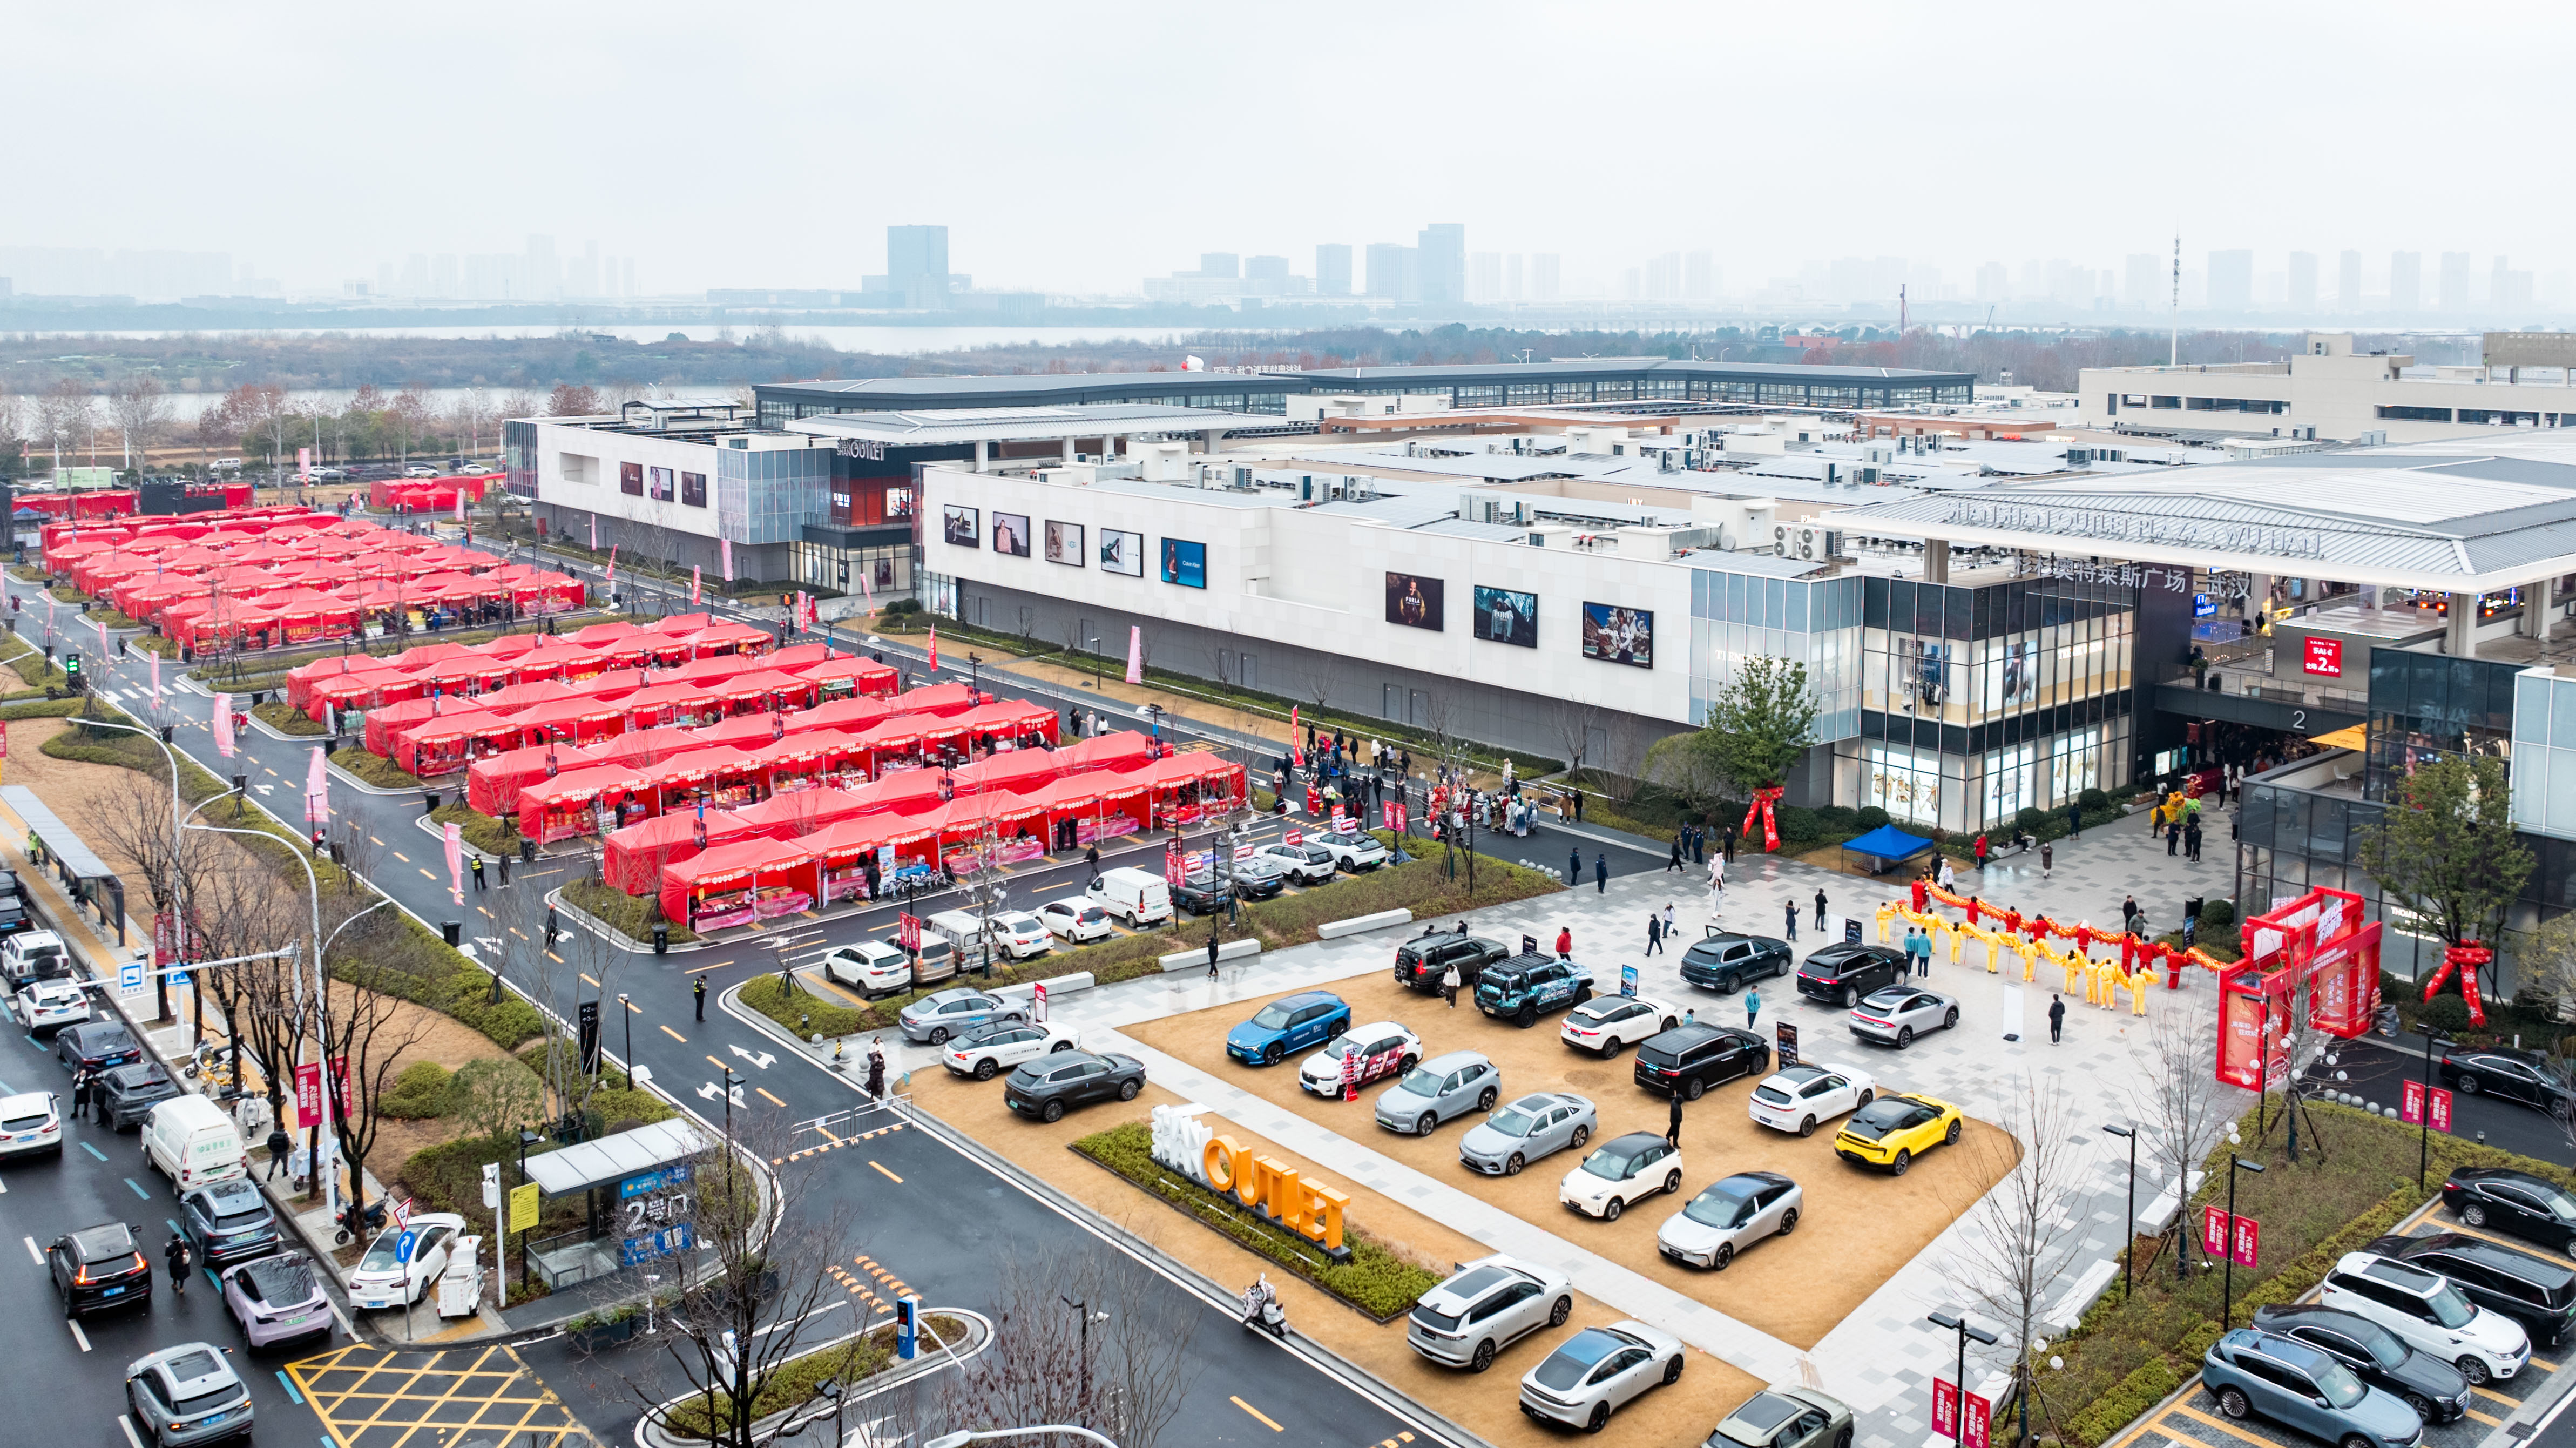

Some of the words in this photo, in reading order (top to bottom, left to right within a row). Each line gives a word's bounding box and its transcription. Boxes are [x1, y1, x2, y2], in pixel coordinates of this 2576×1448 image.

[850, 441, 884, 461] OUTLET
[1946, 501, 2052, 528] SHANSHAN
[2056, 511, 2131, 534] OUTLET
[2138, 518, 2204, 541] PLAZA
[2223, 526, 2261, 547] WU
[2270, 530, 2320, 554] HAN
[1405, 596, 1420, 604] FURLA
[1494, 611, 1514, 619] PORTS
[2293, 710, 2305, 729] 2
[309, 1085, 319, 1116] 为你而来
[1204, 1135, 1350, 1250] OUTLET
[400, 1208, 405, 1218] 让
